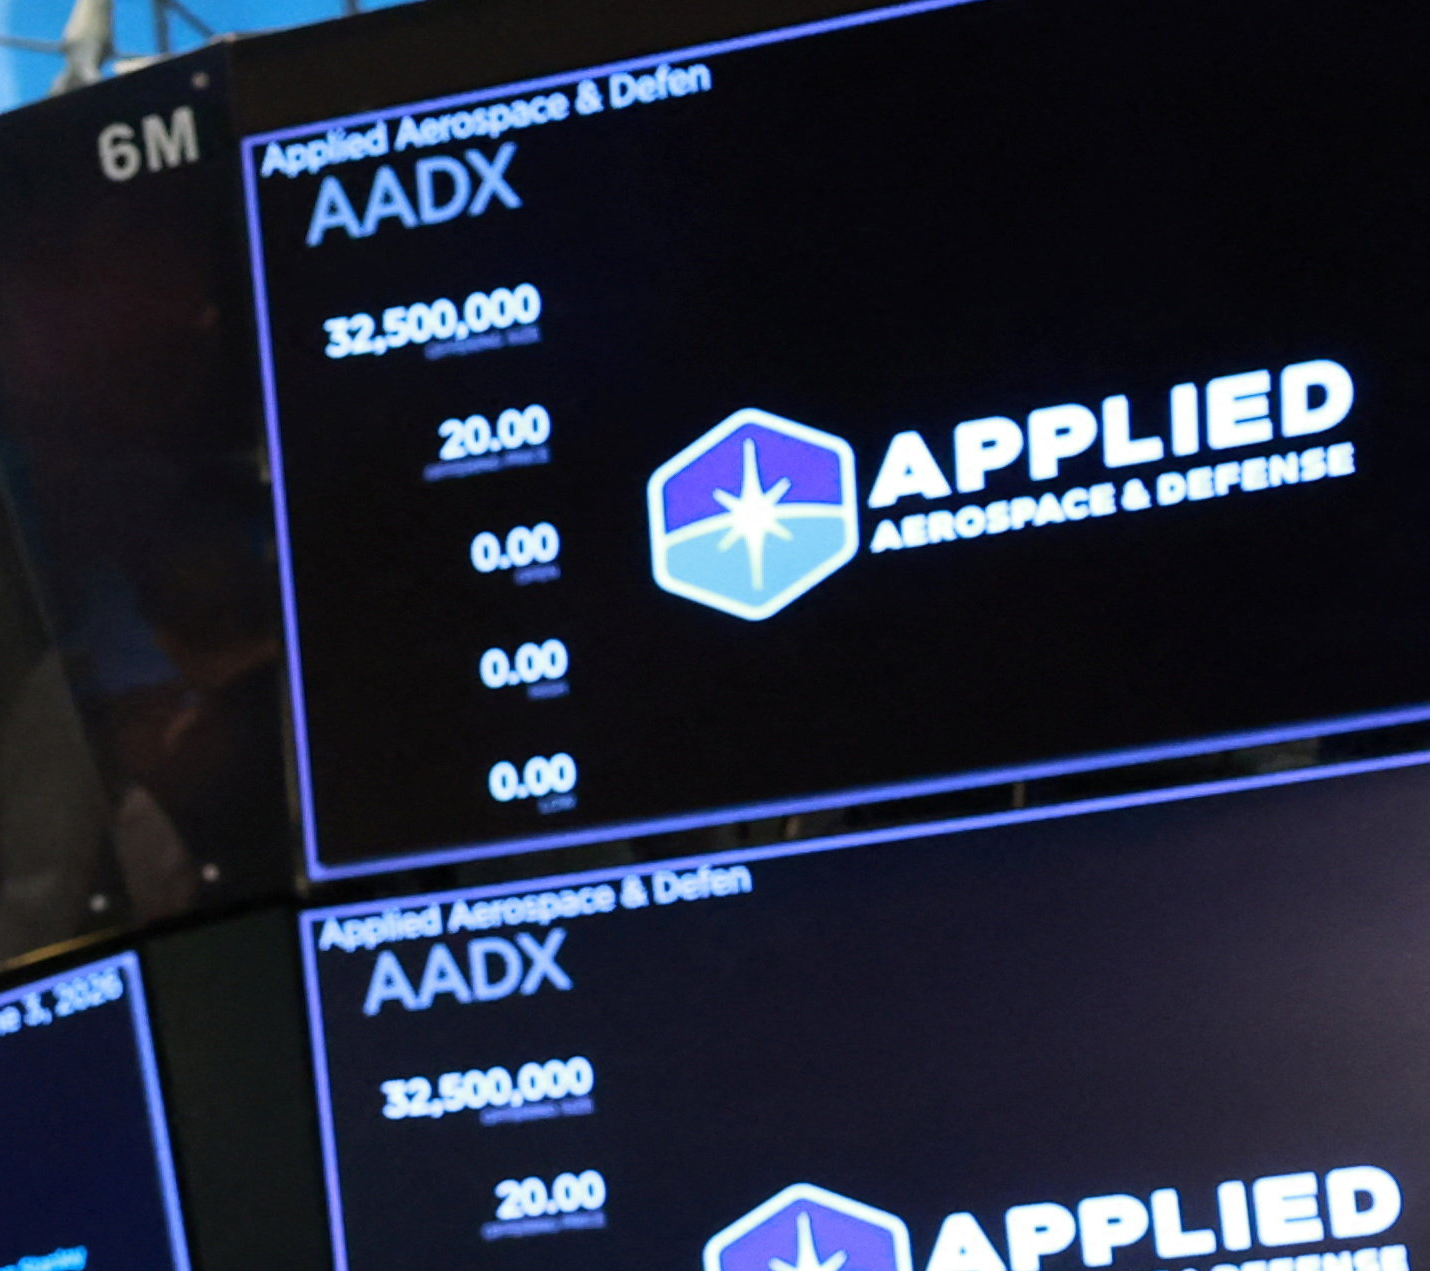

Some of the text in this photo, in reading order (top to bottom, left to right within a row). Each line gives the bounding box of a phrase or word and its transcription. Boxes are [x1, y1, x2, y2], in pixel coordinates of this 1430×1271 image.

[98, 105, 198, 181] 6M
[260, 63, 711, 178] Applied Aerospace & Defen
[306, 141, 523, 247] AADX
[323, 282, 541, 359] 32,500,000
[438, 404, 550, 460] 20.00
[867, 359, 1355, 509] APPLIED
[869, 441, 1355, 553] AEROSPACE & DEFENSE
[470, 521, 560, 573] 0.00
[479, 638, 568, 688] 0.00
[488, 752, 577, 802] 0.00
[319, 864, 753, 951] Applied Aerospace & Defen
[362, 927, 574, 1017] AADX
[380, 1055, 594, 1120] 32,500,000
[494, 1169, 606, 1221] 20.00
